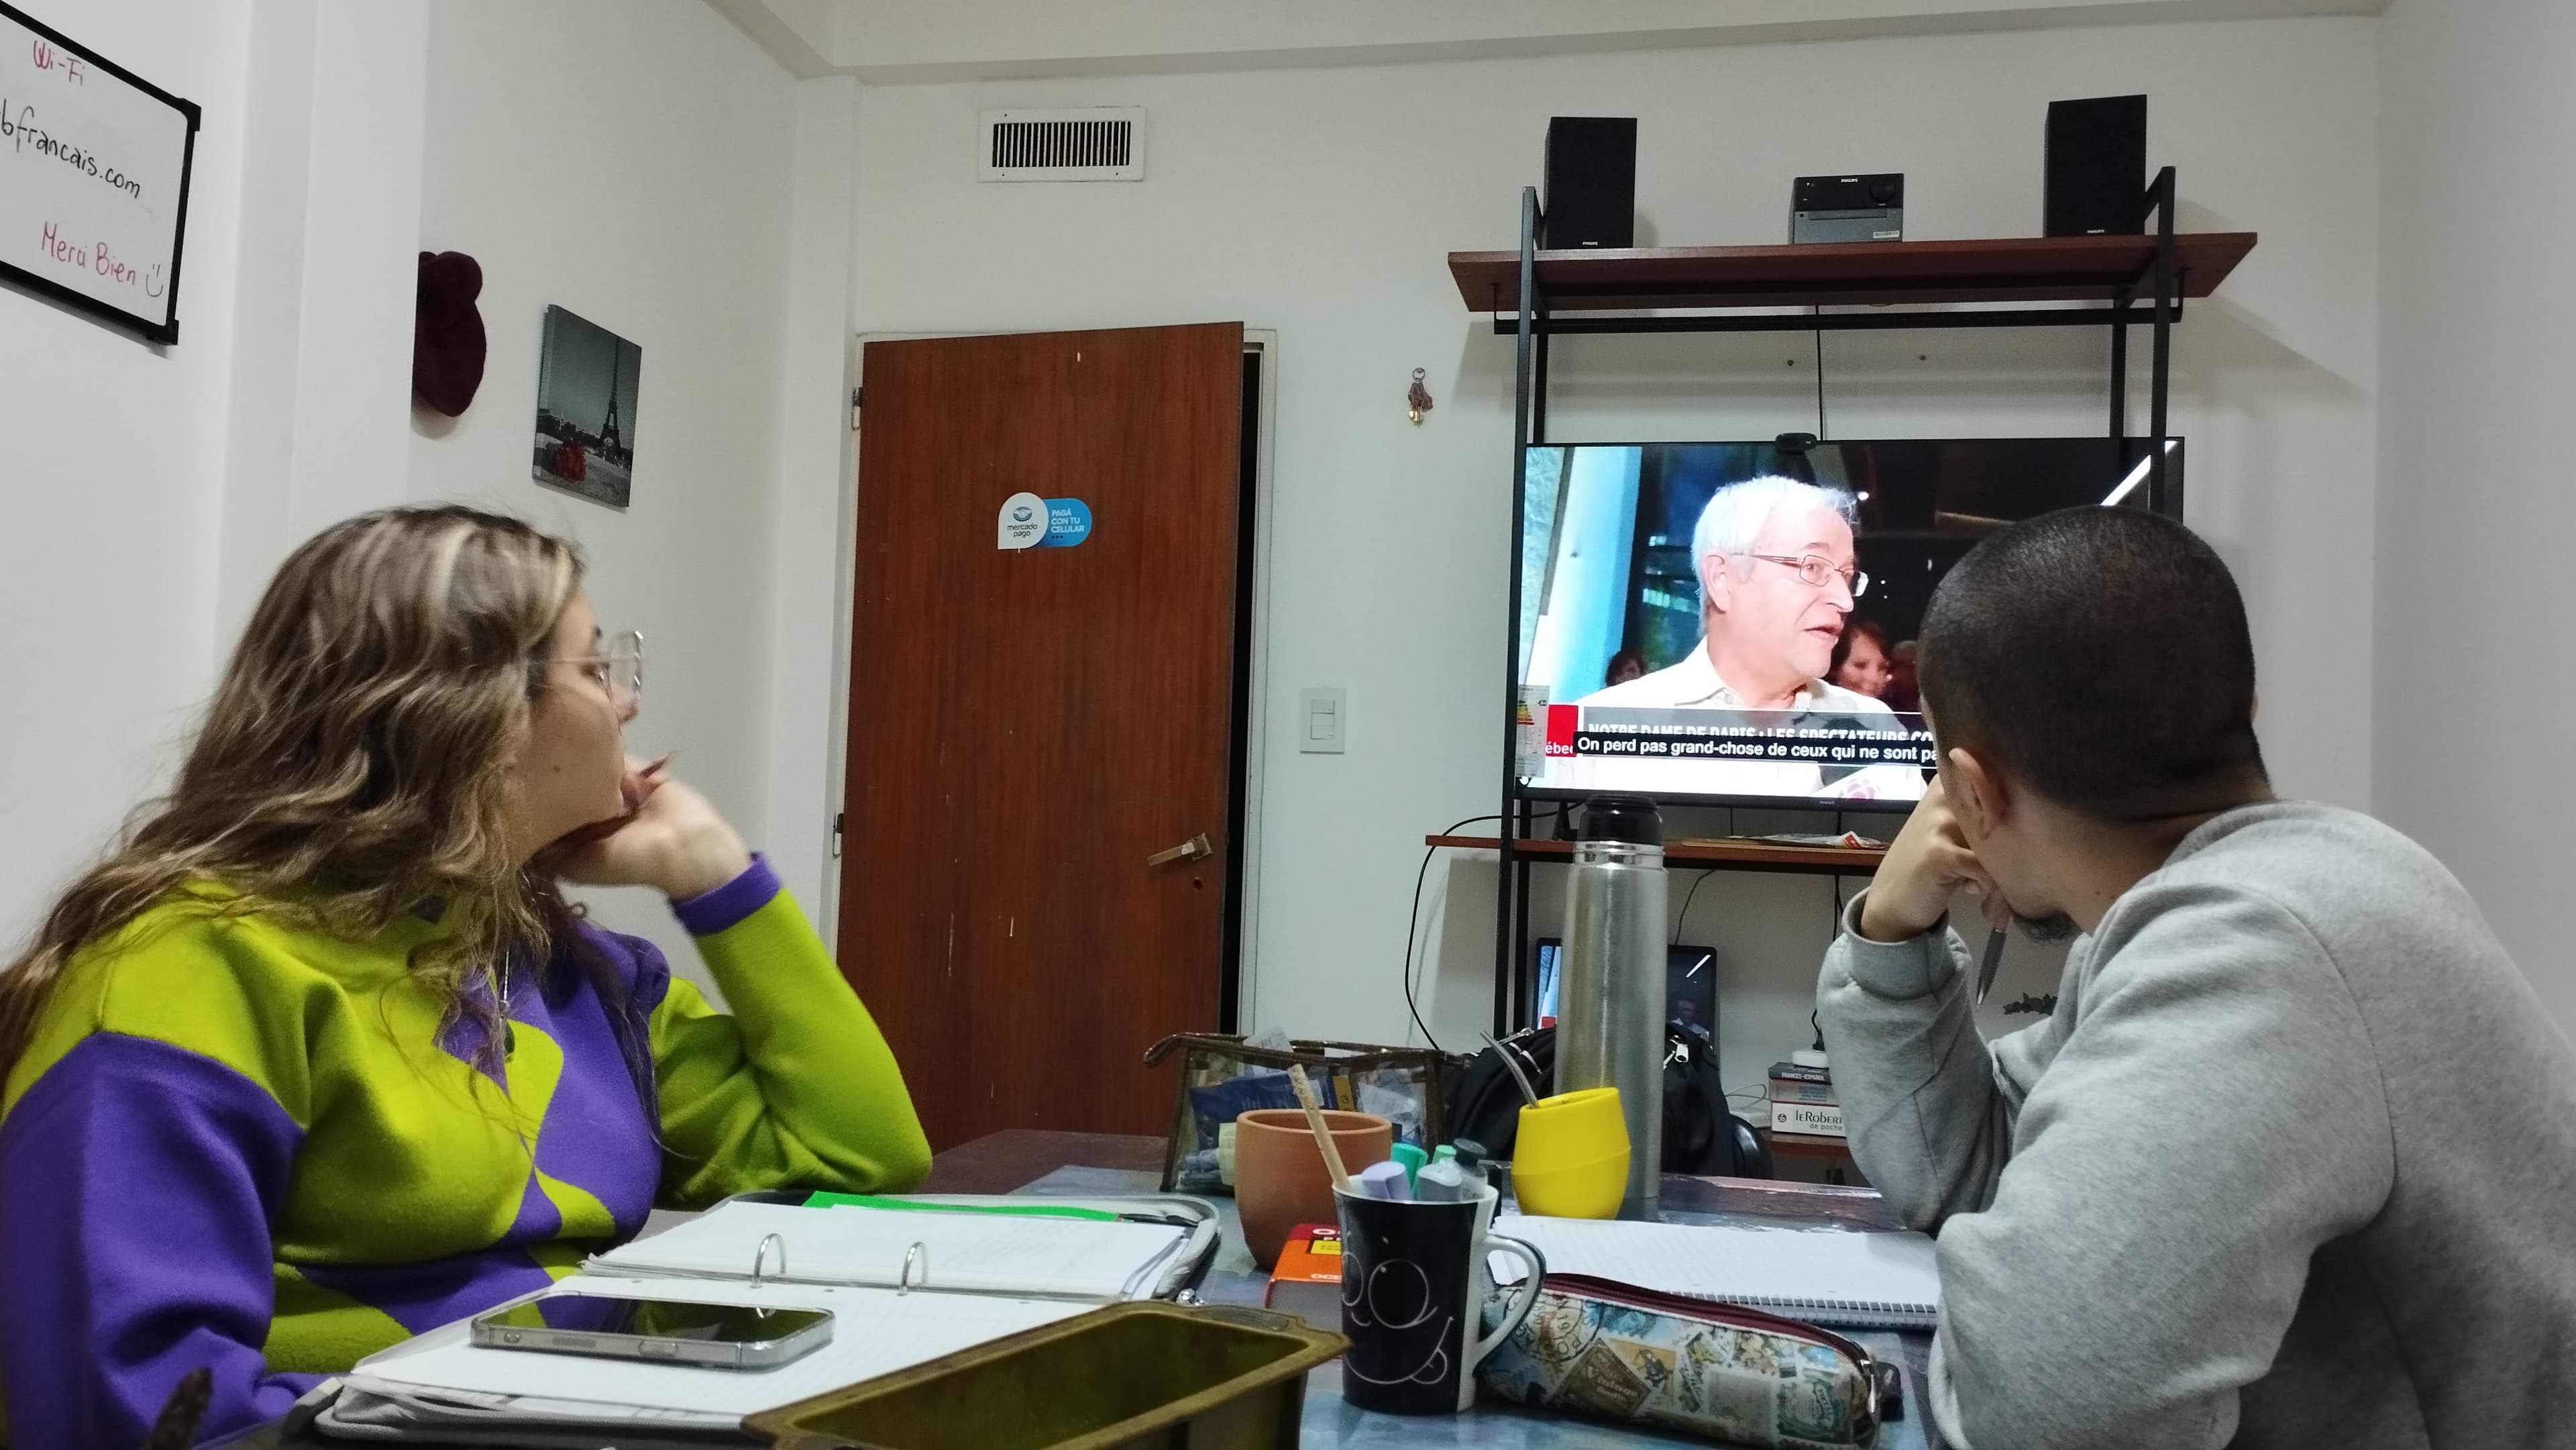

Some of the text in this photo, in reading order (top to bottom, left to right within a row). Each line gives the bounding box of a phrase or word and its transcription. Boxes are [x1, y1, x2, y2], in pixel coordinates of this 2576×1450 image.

[33, 40, 85, 85] Wi-Fi
[95, 242, 136, 285] Bien
[1051, 517, 1069, 525] CON
[1007, 523, 1038, 531] mercado
[1051, 525, 1085, 533] CELULAR
[1578, 737, 1600, 751] On
[1603, 739, 1637, 754] perd
[1640, 741, 1667, 755] pas
[1670, 741, 1764, 756] grand-chose
[1768, 742, 1788, 756] de
[1790, 745, 1828, 758] ceux
[1831, 744, 1856, 761] qui
[1859, 747, 1880, 760] ne
[1883, 747, 1919, 760] sont
[1821, 1123, 1843, 1132] poche
